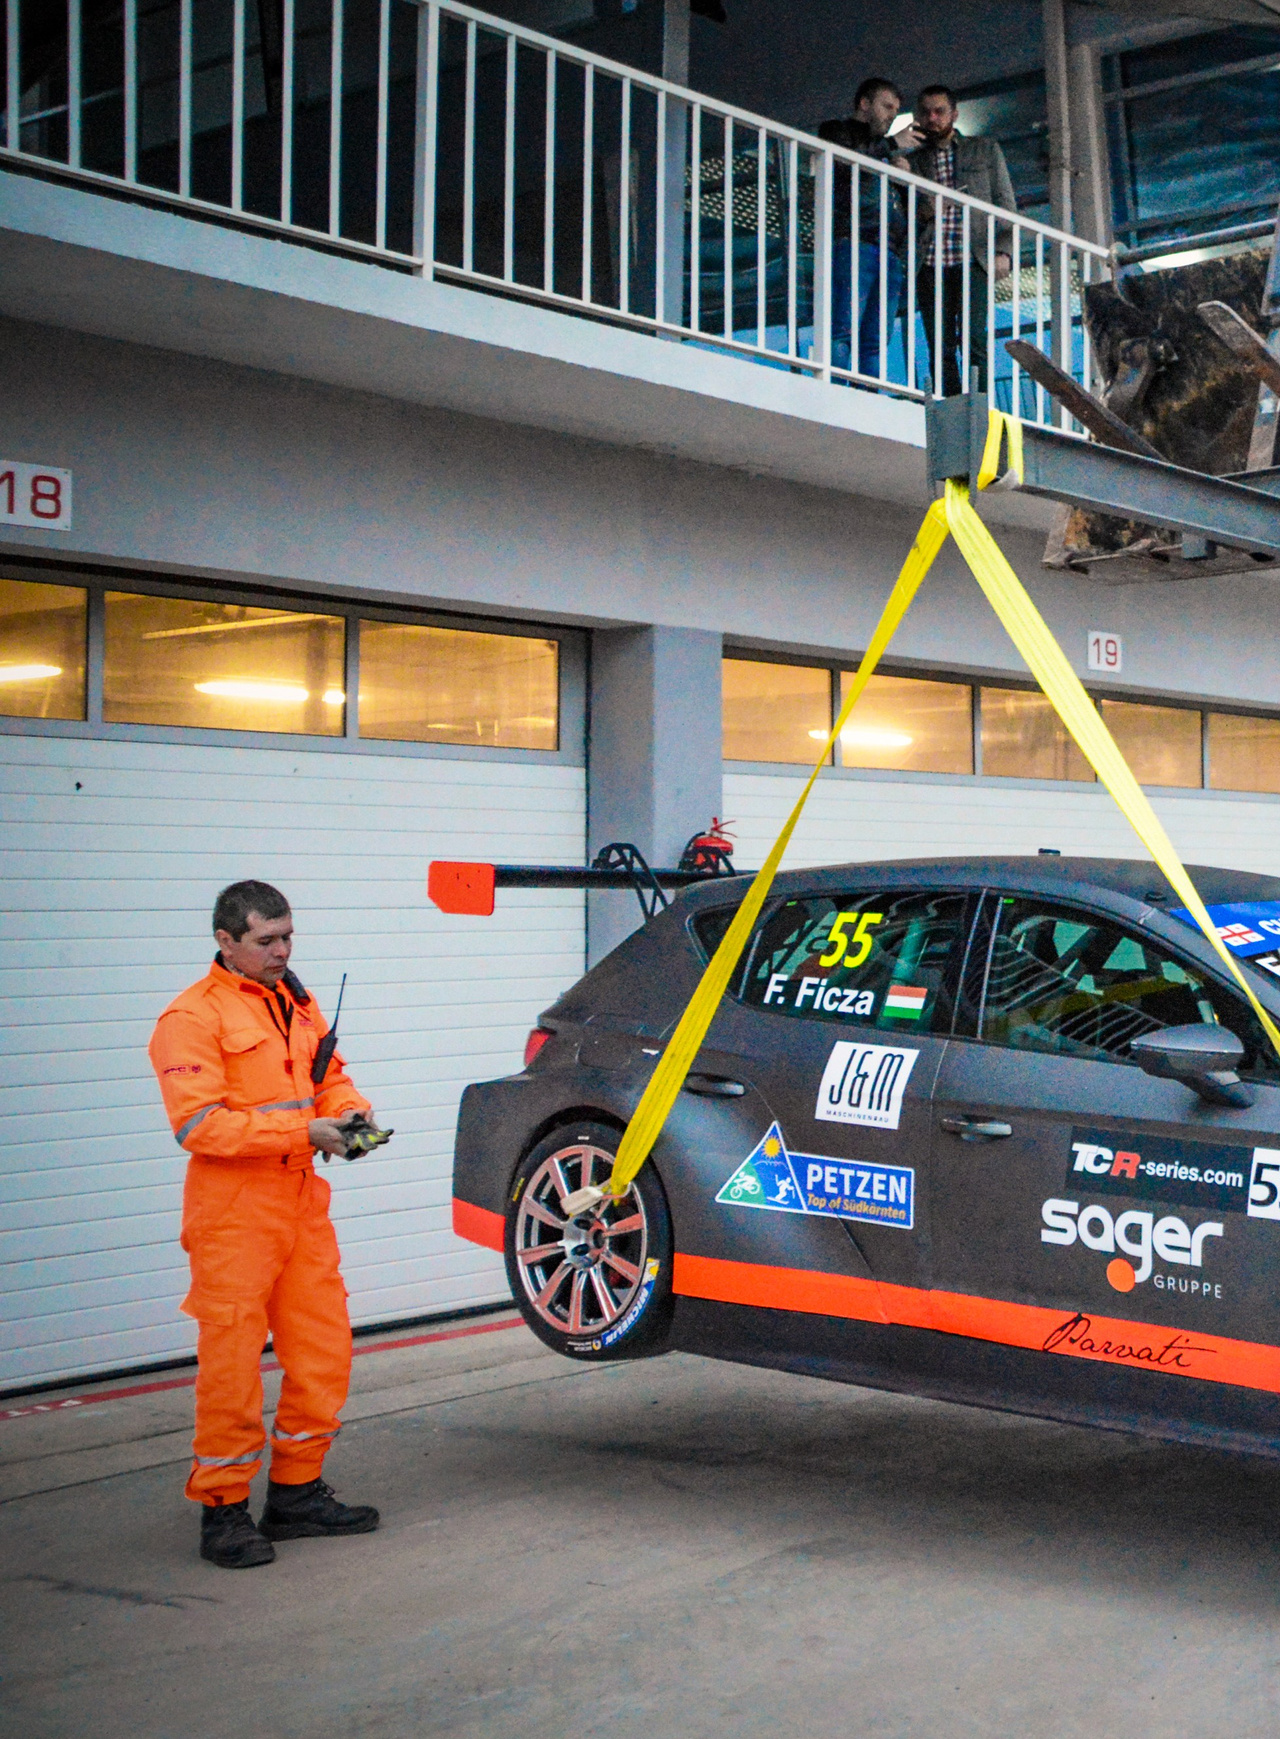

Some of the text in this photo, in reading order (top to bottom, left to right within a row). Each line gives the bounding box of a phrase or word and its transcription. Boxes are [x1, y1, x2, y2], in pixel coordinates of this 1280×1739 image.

[0, 470, 62, 520] 18
[1092, 637, 1118, 667] 19
[818, 911, 884, 969] 55
[763, 973, 876, 1016] F. Ficza
[829, 1048, 905, 1112] J&M
[825, 1109, 890, 1124] MASCHINENBAU
[806, 1163, 907, 1205] PETZEN
[1071, 1142, 1244, 1188] TCR-series.com
[807, 1193, 907, 1221] Top of Südkärnten
[1040, 1197, 1224, 1284] sager
[1153, 1273, 1223, 1300] GRUPPE
[605, 1287, 649, 1346] MICHELIN
[1042, 1312, 1218, 1369] Parvati
